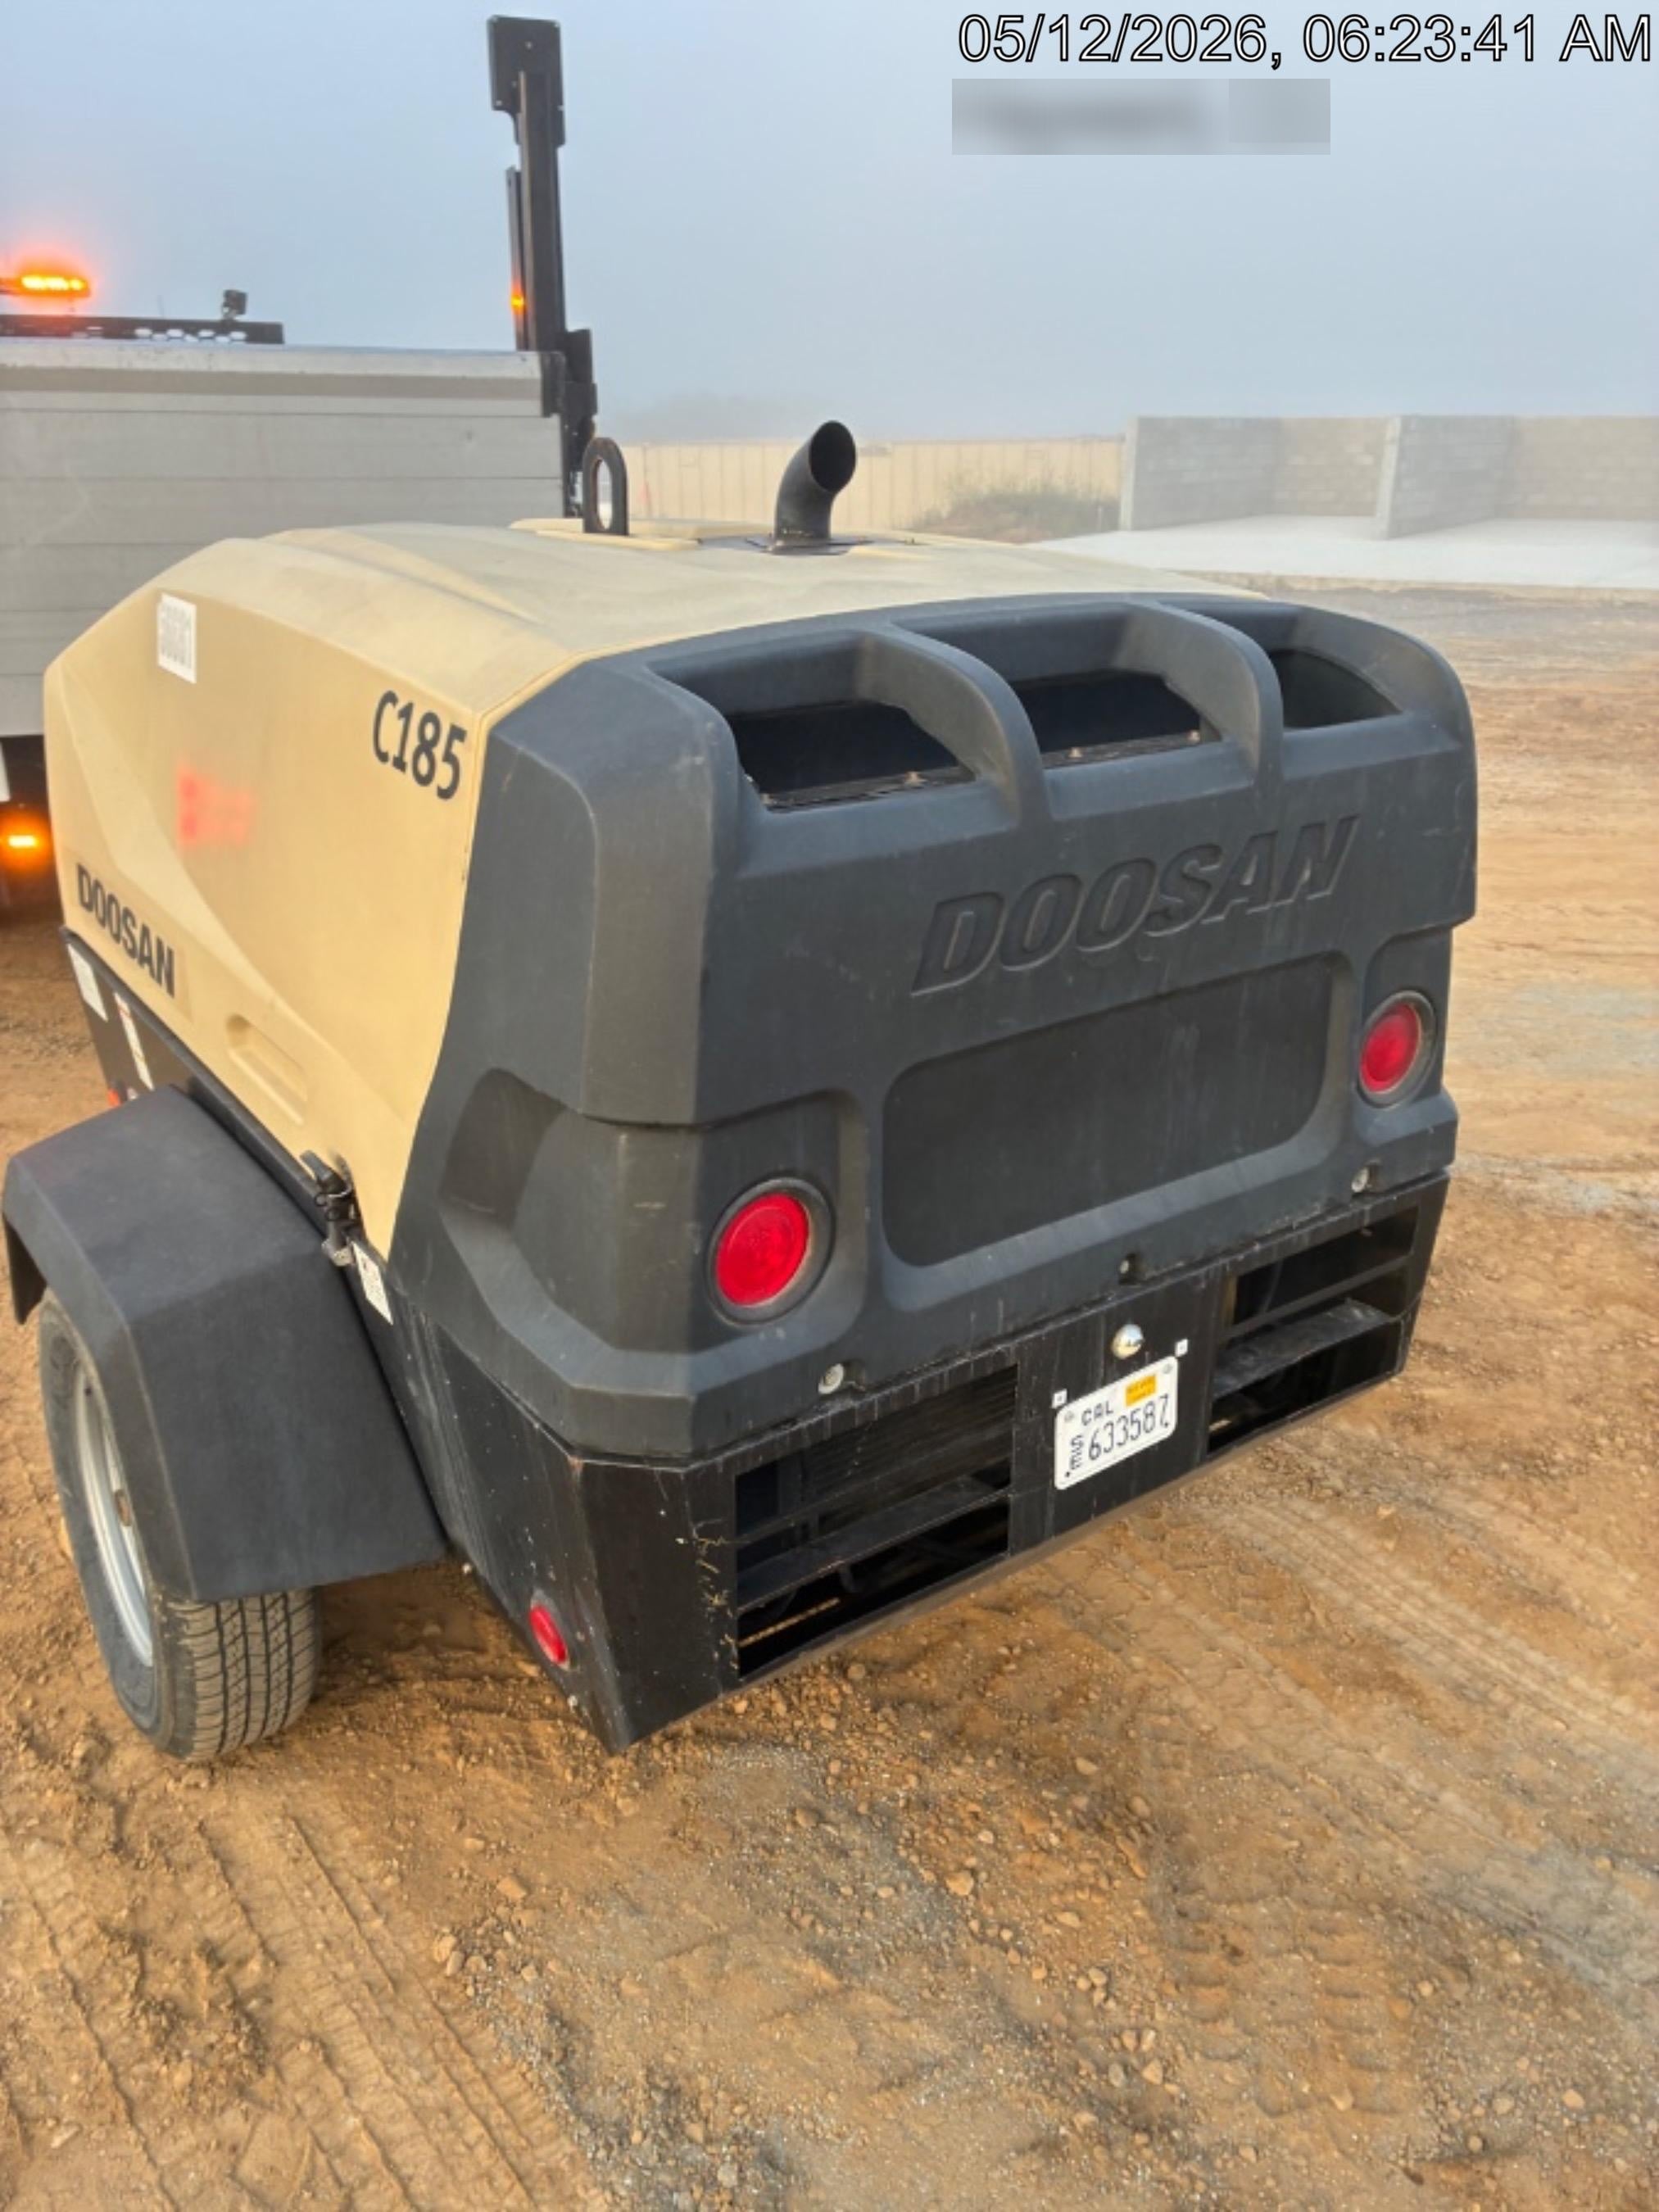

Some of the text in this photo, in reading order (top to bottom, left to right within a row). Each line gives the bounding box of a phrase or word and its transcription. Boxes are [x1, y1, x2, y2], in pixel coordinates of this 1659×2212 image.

[373, 690, 467, 800] C185
[76, 863, 175, 999] DOOSAN
[910, 815, 1360, 997] DOOSAN
[1081, 1401, 1114, 1426] CAL
[1089, 1393, 1169, 1461] 633587
